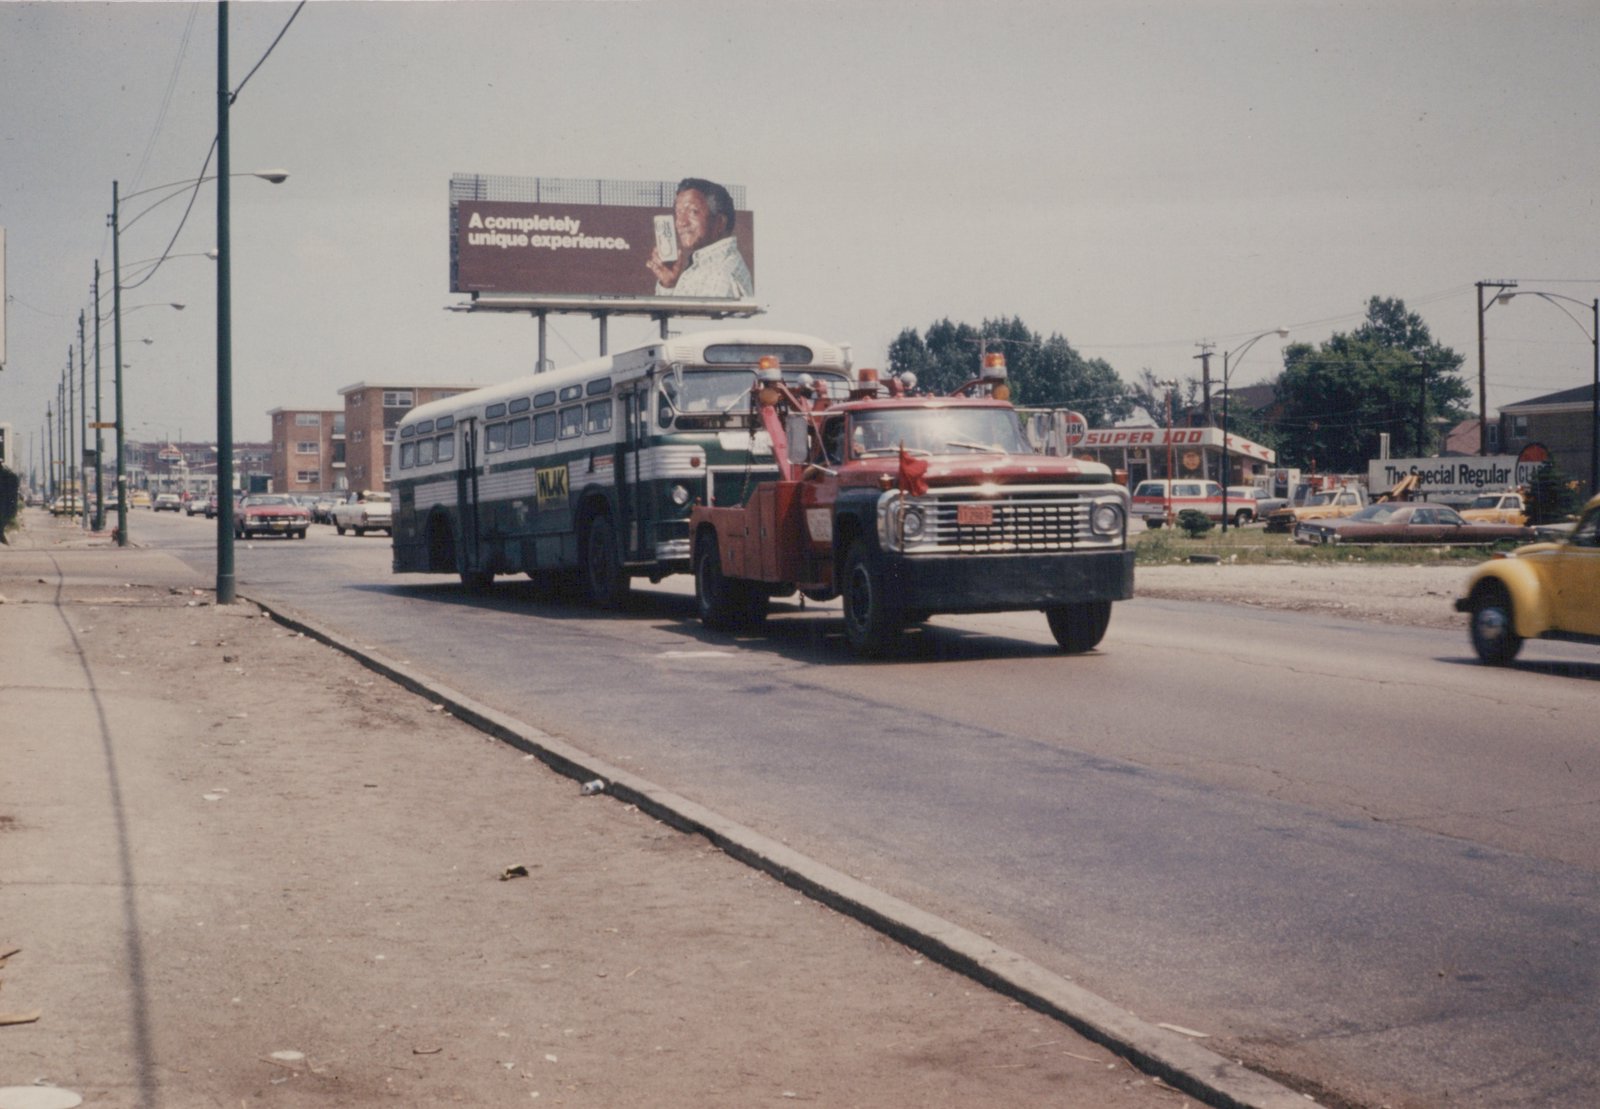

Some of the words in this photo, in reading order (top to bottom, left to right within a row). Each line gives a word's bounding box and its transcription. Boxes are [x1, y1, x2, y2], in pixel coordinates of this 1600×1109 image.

[468, 212, 484, 229] A
[484, 215, 581, 235] completely
[468, 230, 529, 249] unique
[530, 233, 631, 250] experience.
[1085, 432, 1155, 444] SUPER
[1162, 431, 1203, 443] 100
[1385, 466, 1407, 485] The
[1409, 465, 1455, 485] Special
[1459, 464, 1511, 487] Regular
